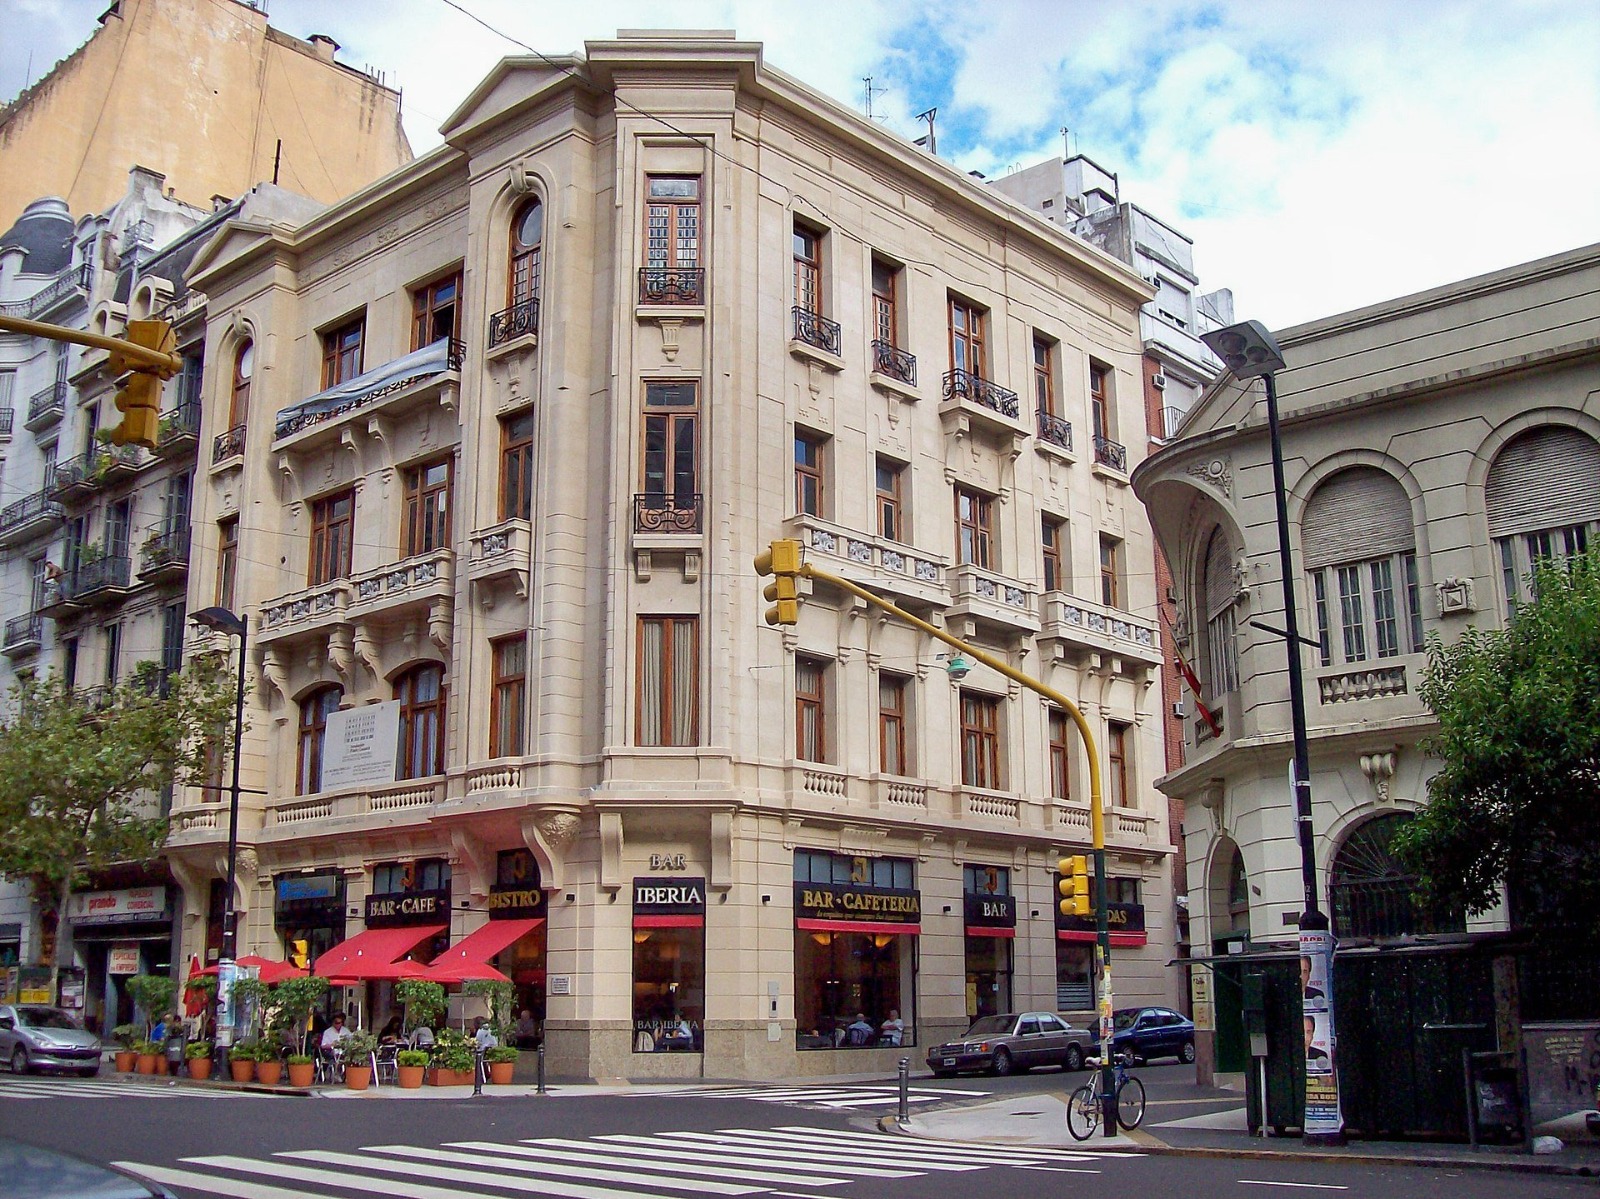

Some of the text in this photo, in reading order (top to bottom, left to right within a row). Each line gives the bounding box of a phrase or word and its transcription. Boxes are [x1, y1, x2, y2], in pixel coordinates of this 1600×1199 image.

[649, 854, 687, 870] BAR
[489, 889, 541, 909] BISTRO
[637, 887, 702, 904] IBERIA
[803, 890, 920, 913] BAR CAFETERIA
[370, 897, 436, 917] BAR CAFE
[983, 902, 1008, 917] BAR
[637, 1020, 699, 1029] BAR IBEIA
